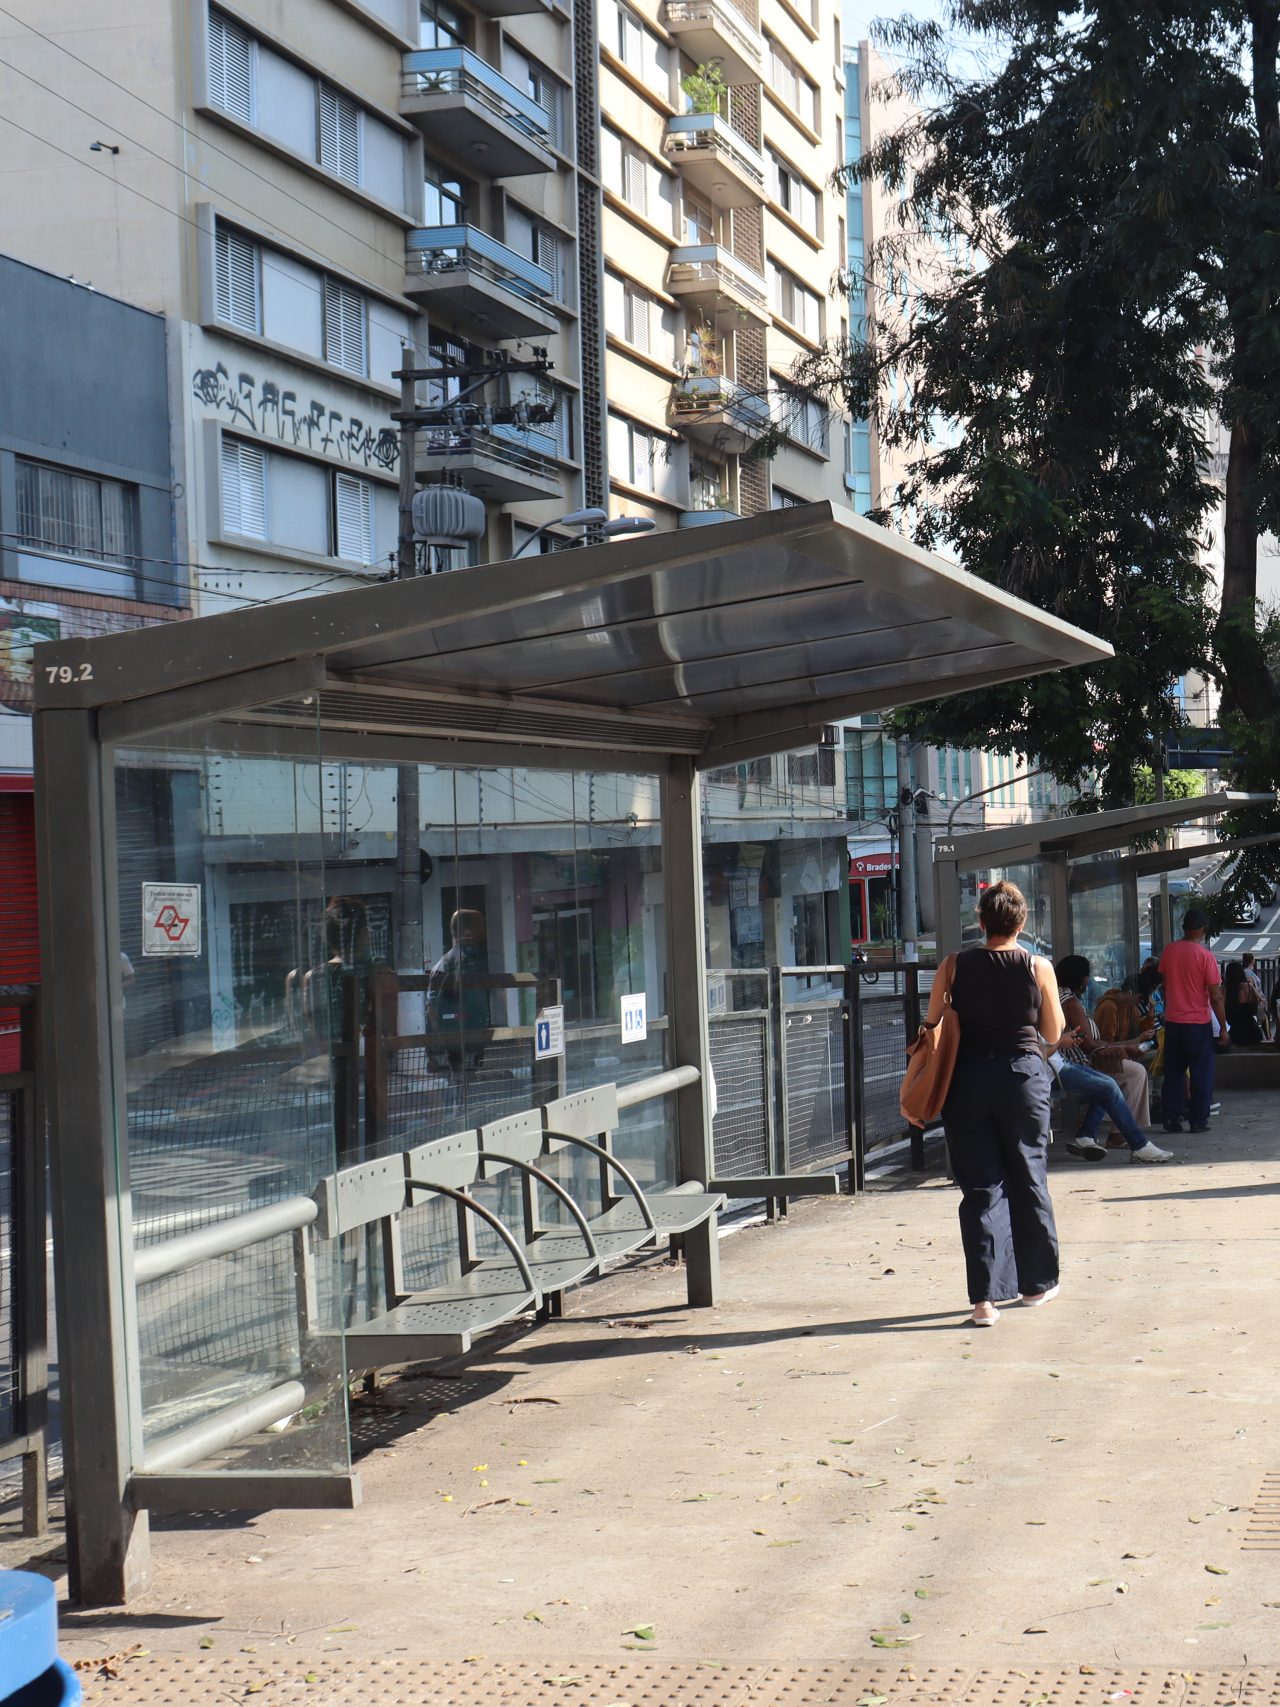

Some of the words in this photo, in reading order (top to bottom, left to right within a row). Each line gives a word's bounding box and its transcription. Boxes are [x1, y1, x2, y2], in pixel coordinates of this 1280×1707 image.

[45, 663, 94, 684] 79.2
[937, 844, 956, 853] 79.1
[866, 863, 900, 871] Bradeso
